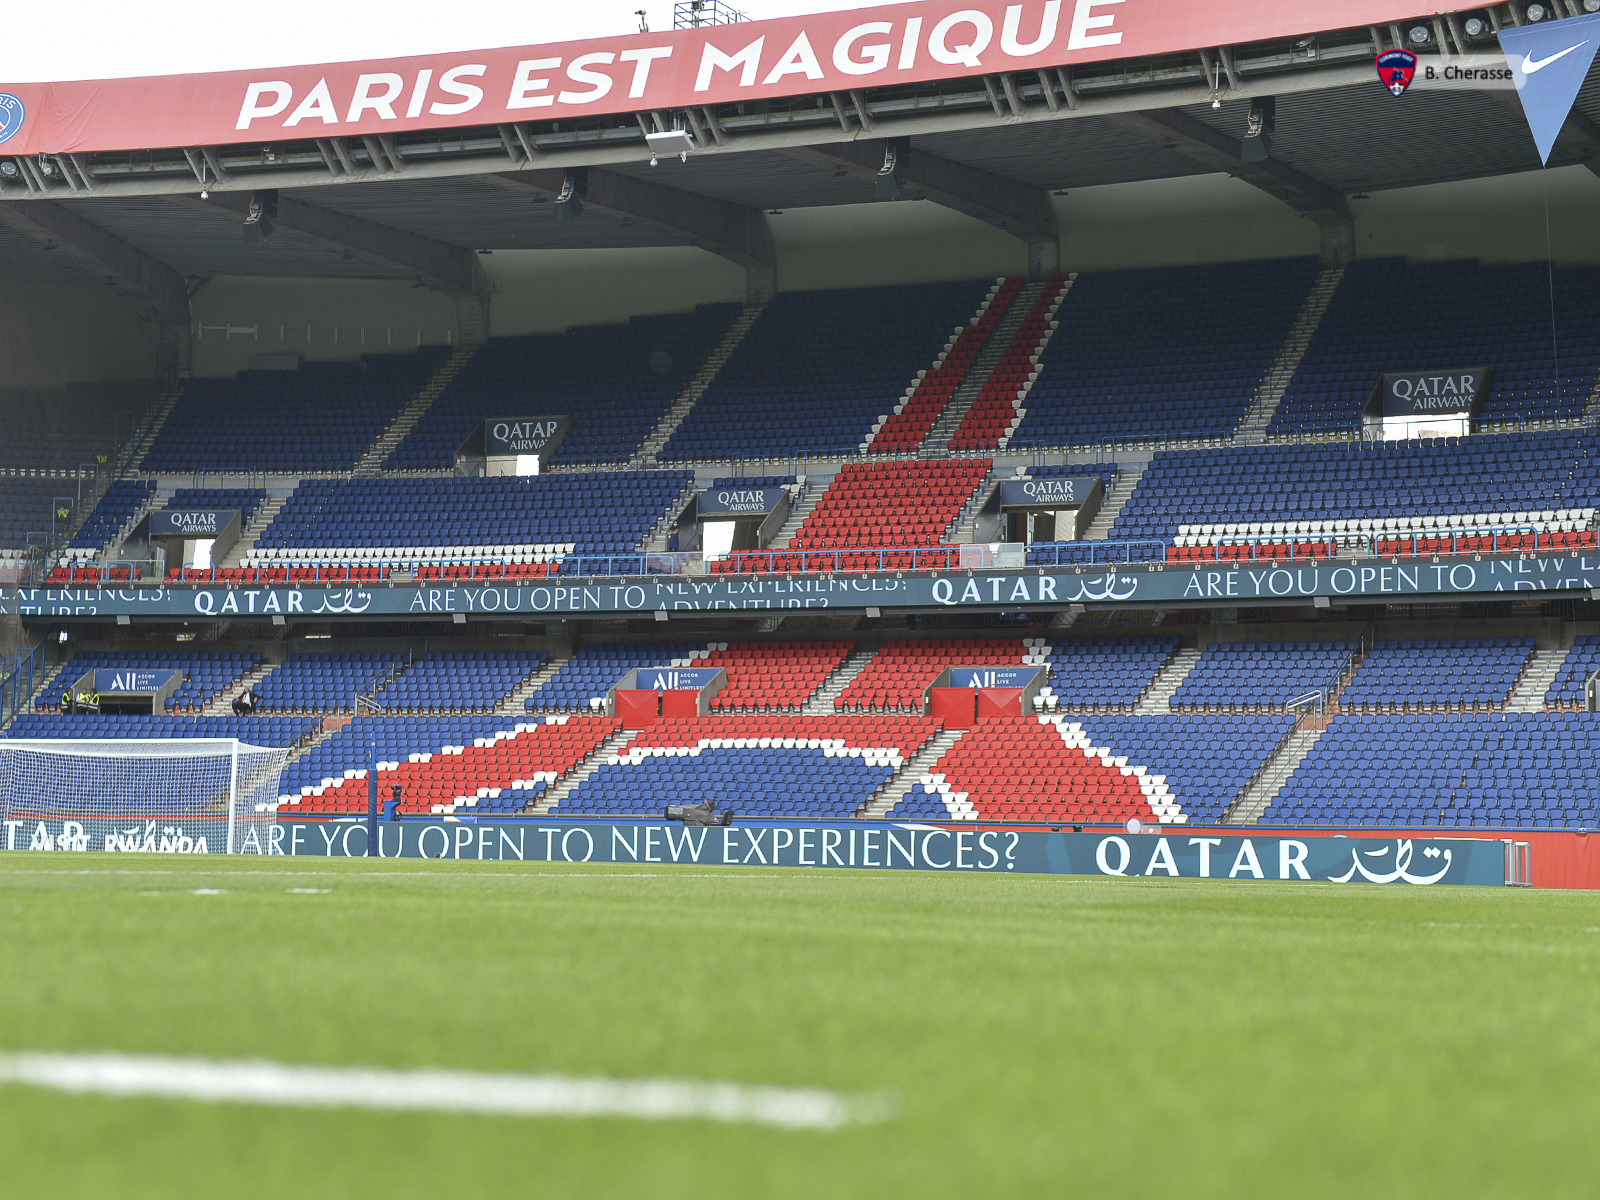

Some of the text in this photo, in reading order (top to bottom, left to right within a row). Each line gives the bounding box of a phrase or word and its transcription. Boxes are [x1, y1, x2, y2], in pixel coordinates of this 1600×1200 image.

[235, 0, 1124, 130] PARIS EST MAGIQUE
[1392, 375, 1475, 401] QATAR
[1413, 394, 1474, 409] AIRWAYS
[493, 421, 558, 443] QATAR
[509, 438, 548, 450] AIRWA
[717, 490, 765, 506] QATAR
[1023, 480, 1074, 497] QATAR
[1035, 493, 1074, 503] AIRWAYS
[729, 502, 765, 511] AIRWAYS
[170, 512, 216, 527] QATAR
[181, 524, 217, 533] AIRWAYS
[1183, 571, 1239, 597] ARE
[1248, 569, 1319, 595] YOU
[1330, 566, 1419, 594] OPEN
[1427, 563, 1476, 591] TO
[409, 588, 456, 612] ARE
[463, 587, 522, 611] YOU
[530, 585, 601, 611] OPEN
[609, 585, 645, 609] TO
[932, 577, 1058, 606] QATAR
[194, 590, 304, 616] QATAR
[104, 833, 209, 854] RWANDA
[240, 824, 1020, 870] ARE YOU OPEN TO NEW EXPERIENCES?
[1095, 836, 1311, 880] QATAR
